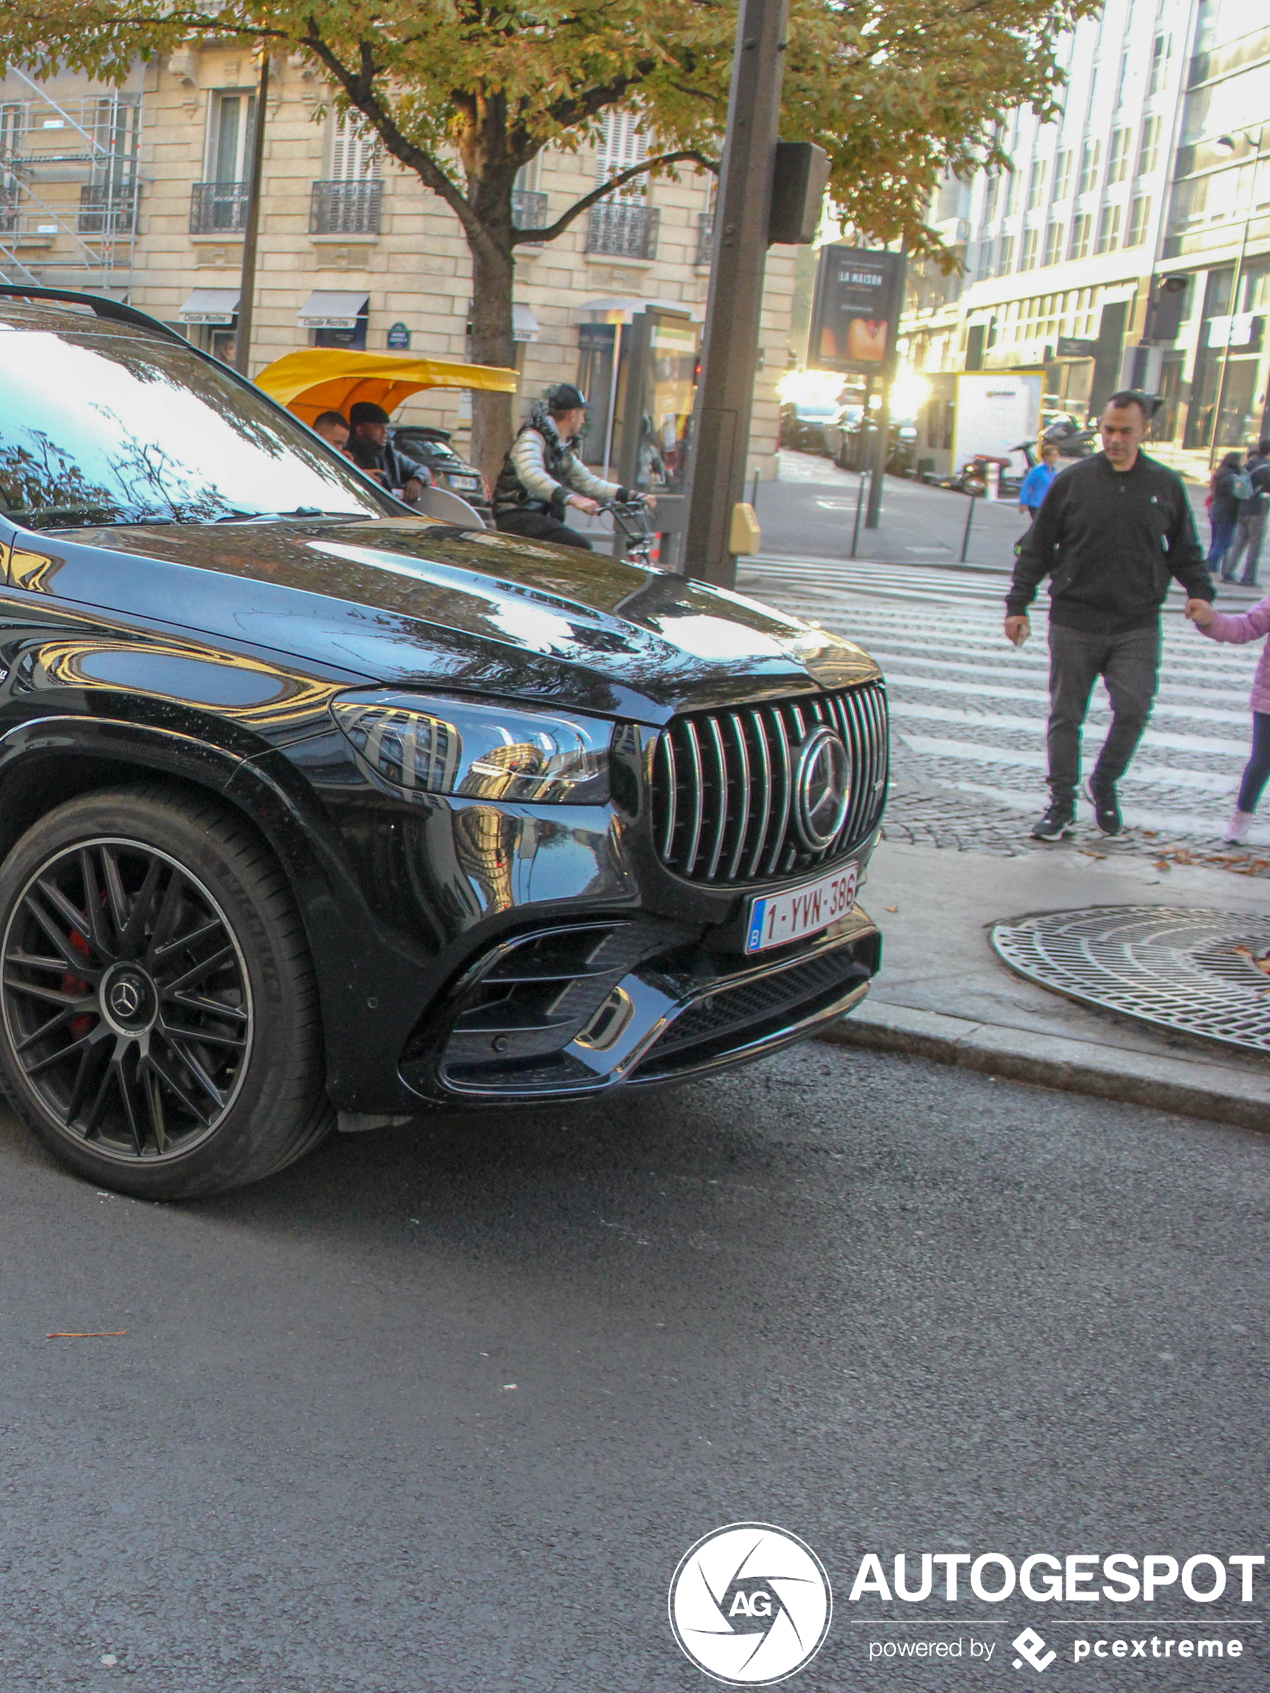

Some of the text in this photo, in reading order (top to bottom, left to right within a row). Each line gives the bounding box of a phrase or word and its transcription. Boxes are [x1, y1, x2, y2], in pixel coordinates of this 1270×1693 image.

[840, 271, 883, 286] LA MAISON
[750, 929, 760, 947] B
